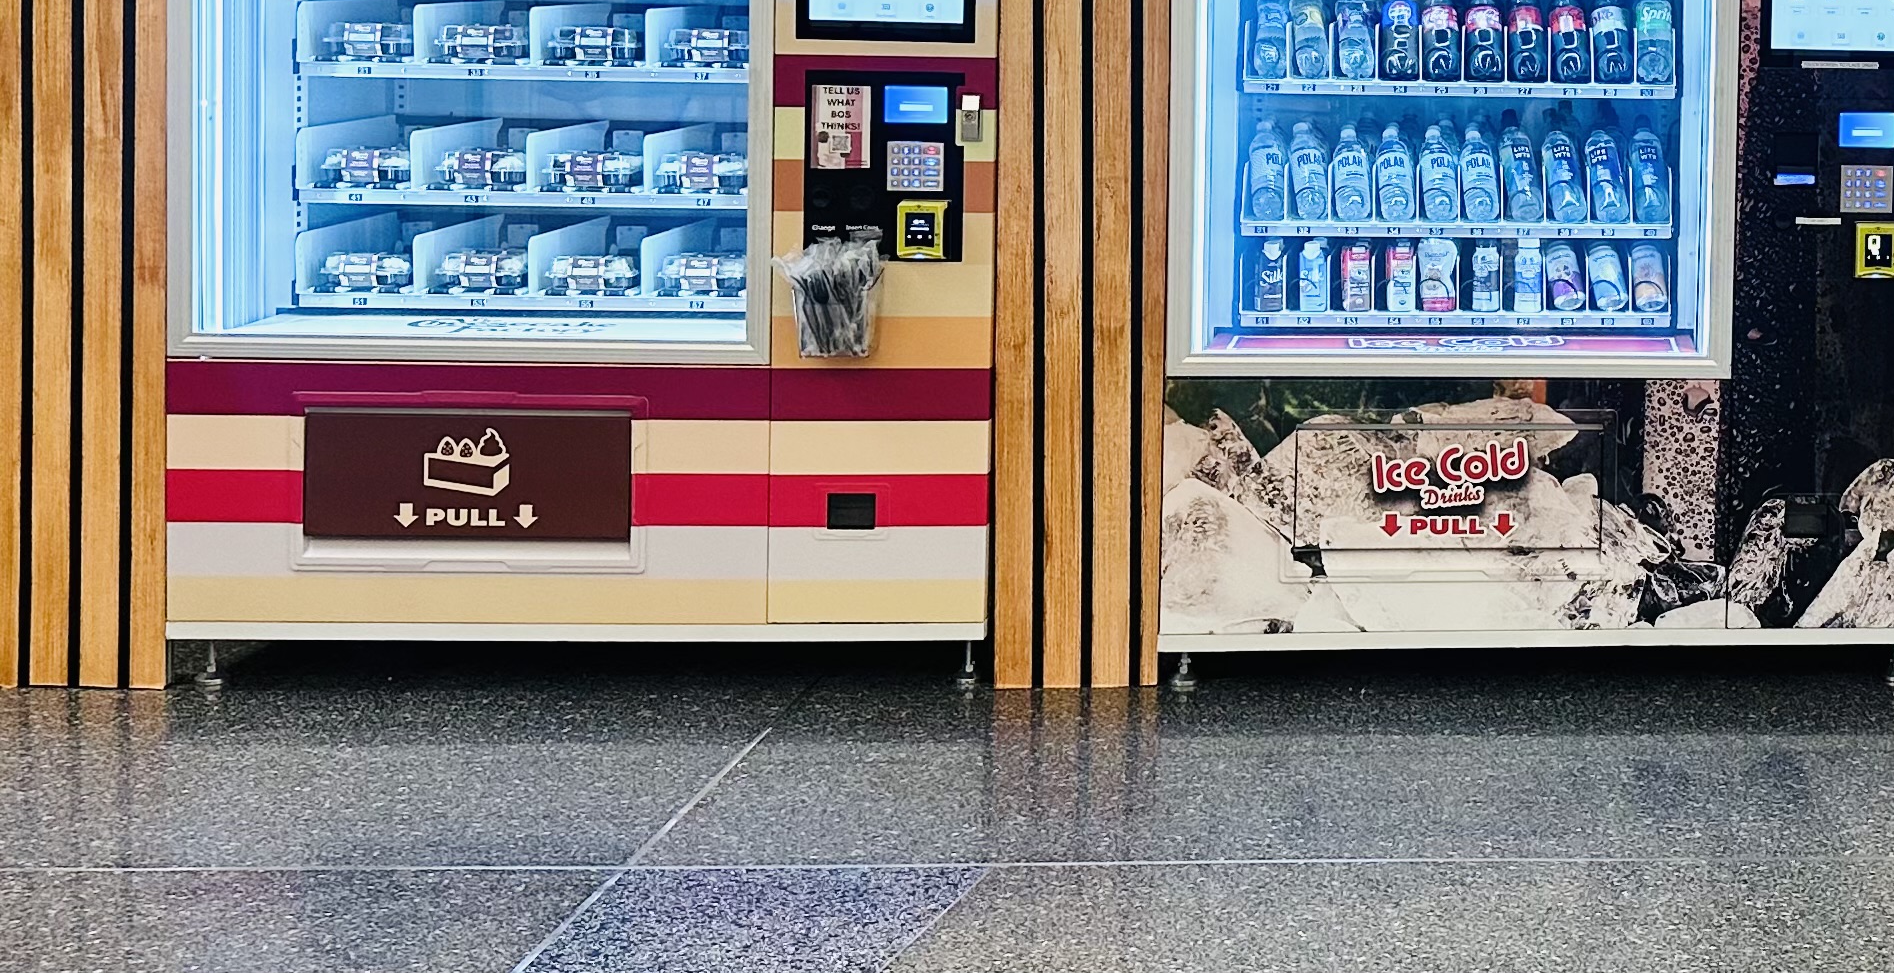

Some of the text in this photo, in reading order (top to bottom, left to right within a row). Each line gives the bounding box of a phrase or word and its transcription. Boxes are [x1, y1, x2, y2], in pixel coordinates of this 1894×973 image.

[847, 87, 860, 95] US
[1520, 87, 1530, 95] 27
[821, 122, 860, 130] THINKS!
[699, 199, 709, 207] 47
[1389, 227, 1399, 235] 34
[1260, 268, 1283, 286] Silk
[1373, 439, 1529, 491] Ice Cold
[1421, 486, 1484, 508] Drinks
[426, 509, 505, 527] PULL
[1410, 518, 1484, 535] PULL
